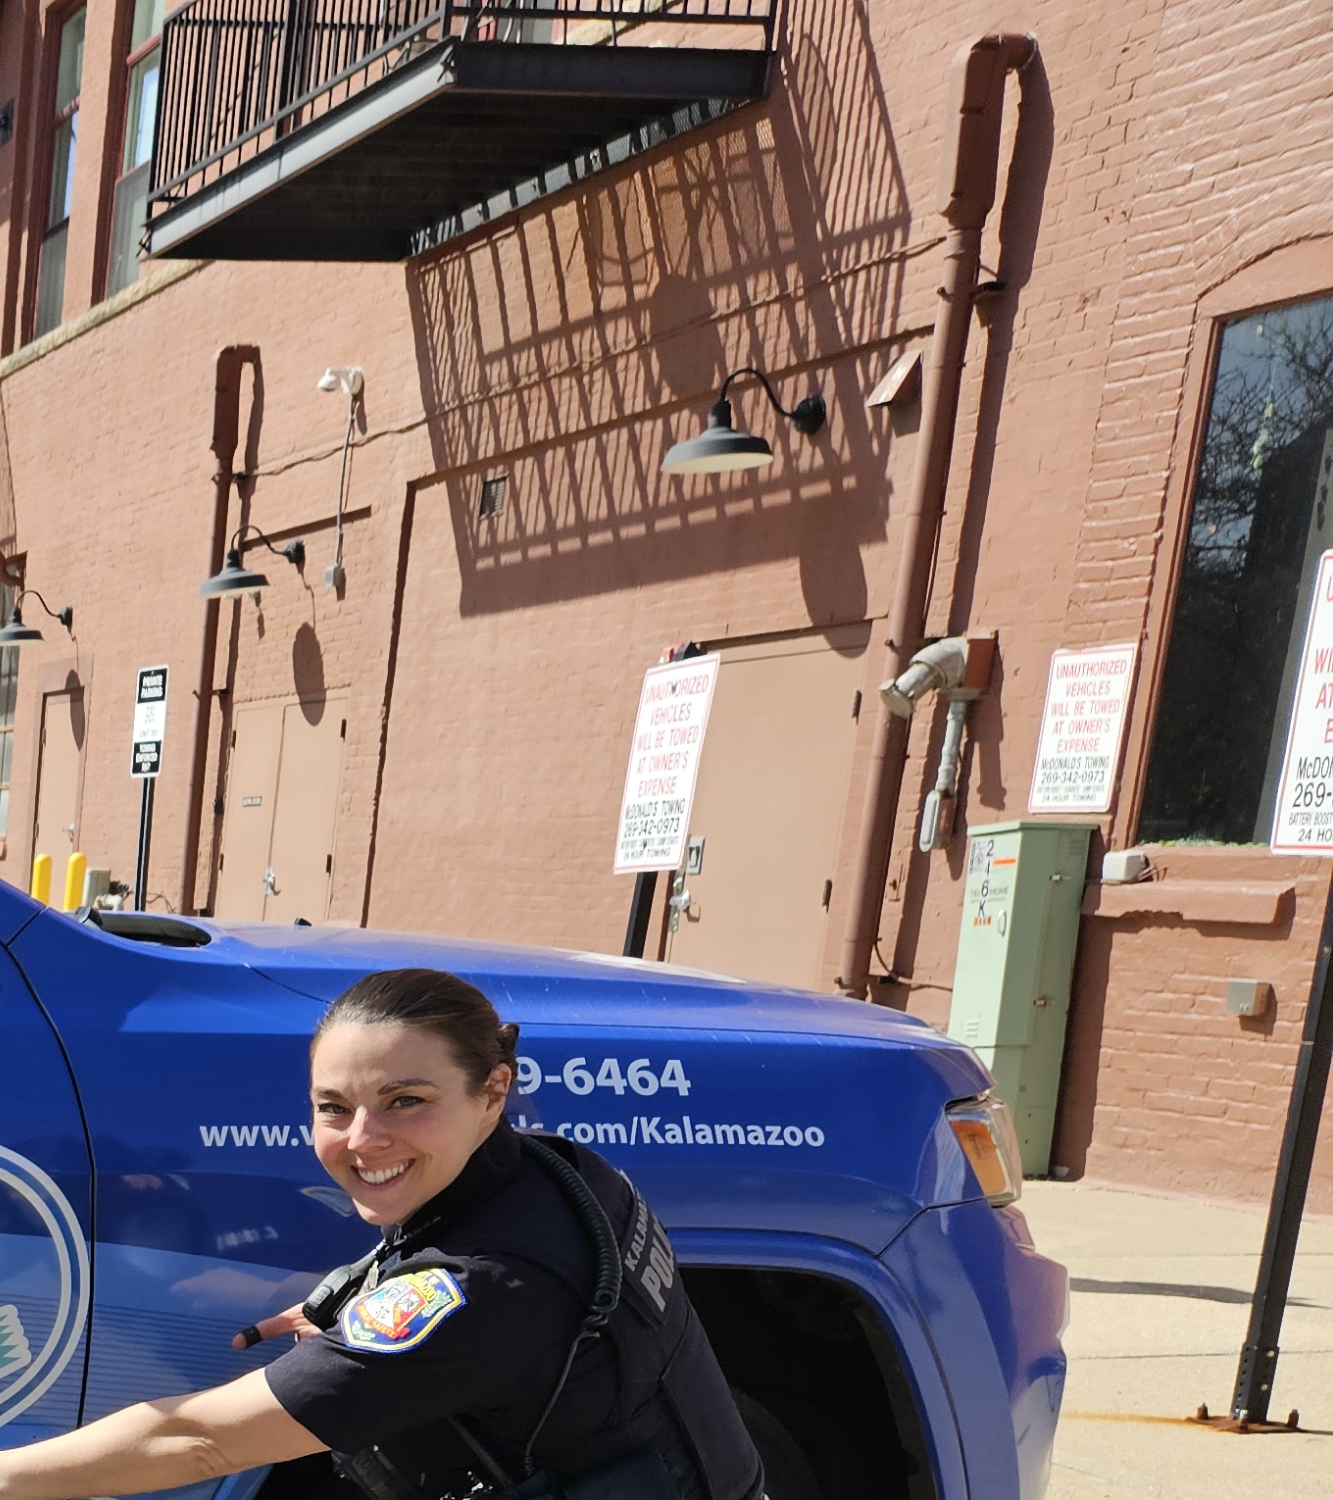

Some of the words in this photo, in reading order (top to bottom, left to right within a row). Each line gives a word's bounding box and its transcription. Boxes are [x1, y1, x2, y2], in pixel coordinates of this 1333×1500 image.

[1056, 659, 1127, 679] UNAUTHORIZED
[1065, 680, 1112, 698] VEHICLES
[650, 702, 693, 727] VEHICLES
[1051, 702, 1070, 717] WILL
[1073, 701, 1085, 716] BE
[1090, 699, 1121, 715] TOWED
[1052, 721, 1065, 736] AT
[1068, 718, 1112, 735] OWNER'S
[637, 731, 653, 752] WILL
[654, 730, 666, 749] BE
[669, 725, 700, 746] TOWED
[1056, 738, 1101, 754] EXPENSE
[648, 751, 690, 772] OWNER'S
[1085, 756, 1110, 769] TOWING
[637, 776, 678, 798] EXPENSE
[1041, 769, 1105, 785] 269-342-0973
[1292, 782, 1333, 808] 269-
[1298, 828, 1313, 842] 24
[515, 1055, 692, 1096] 9-6464
[640, 1213, 675, 1312] POLI
